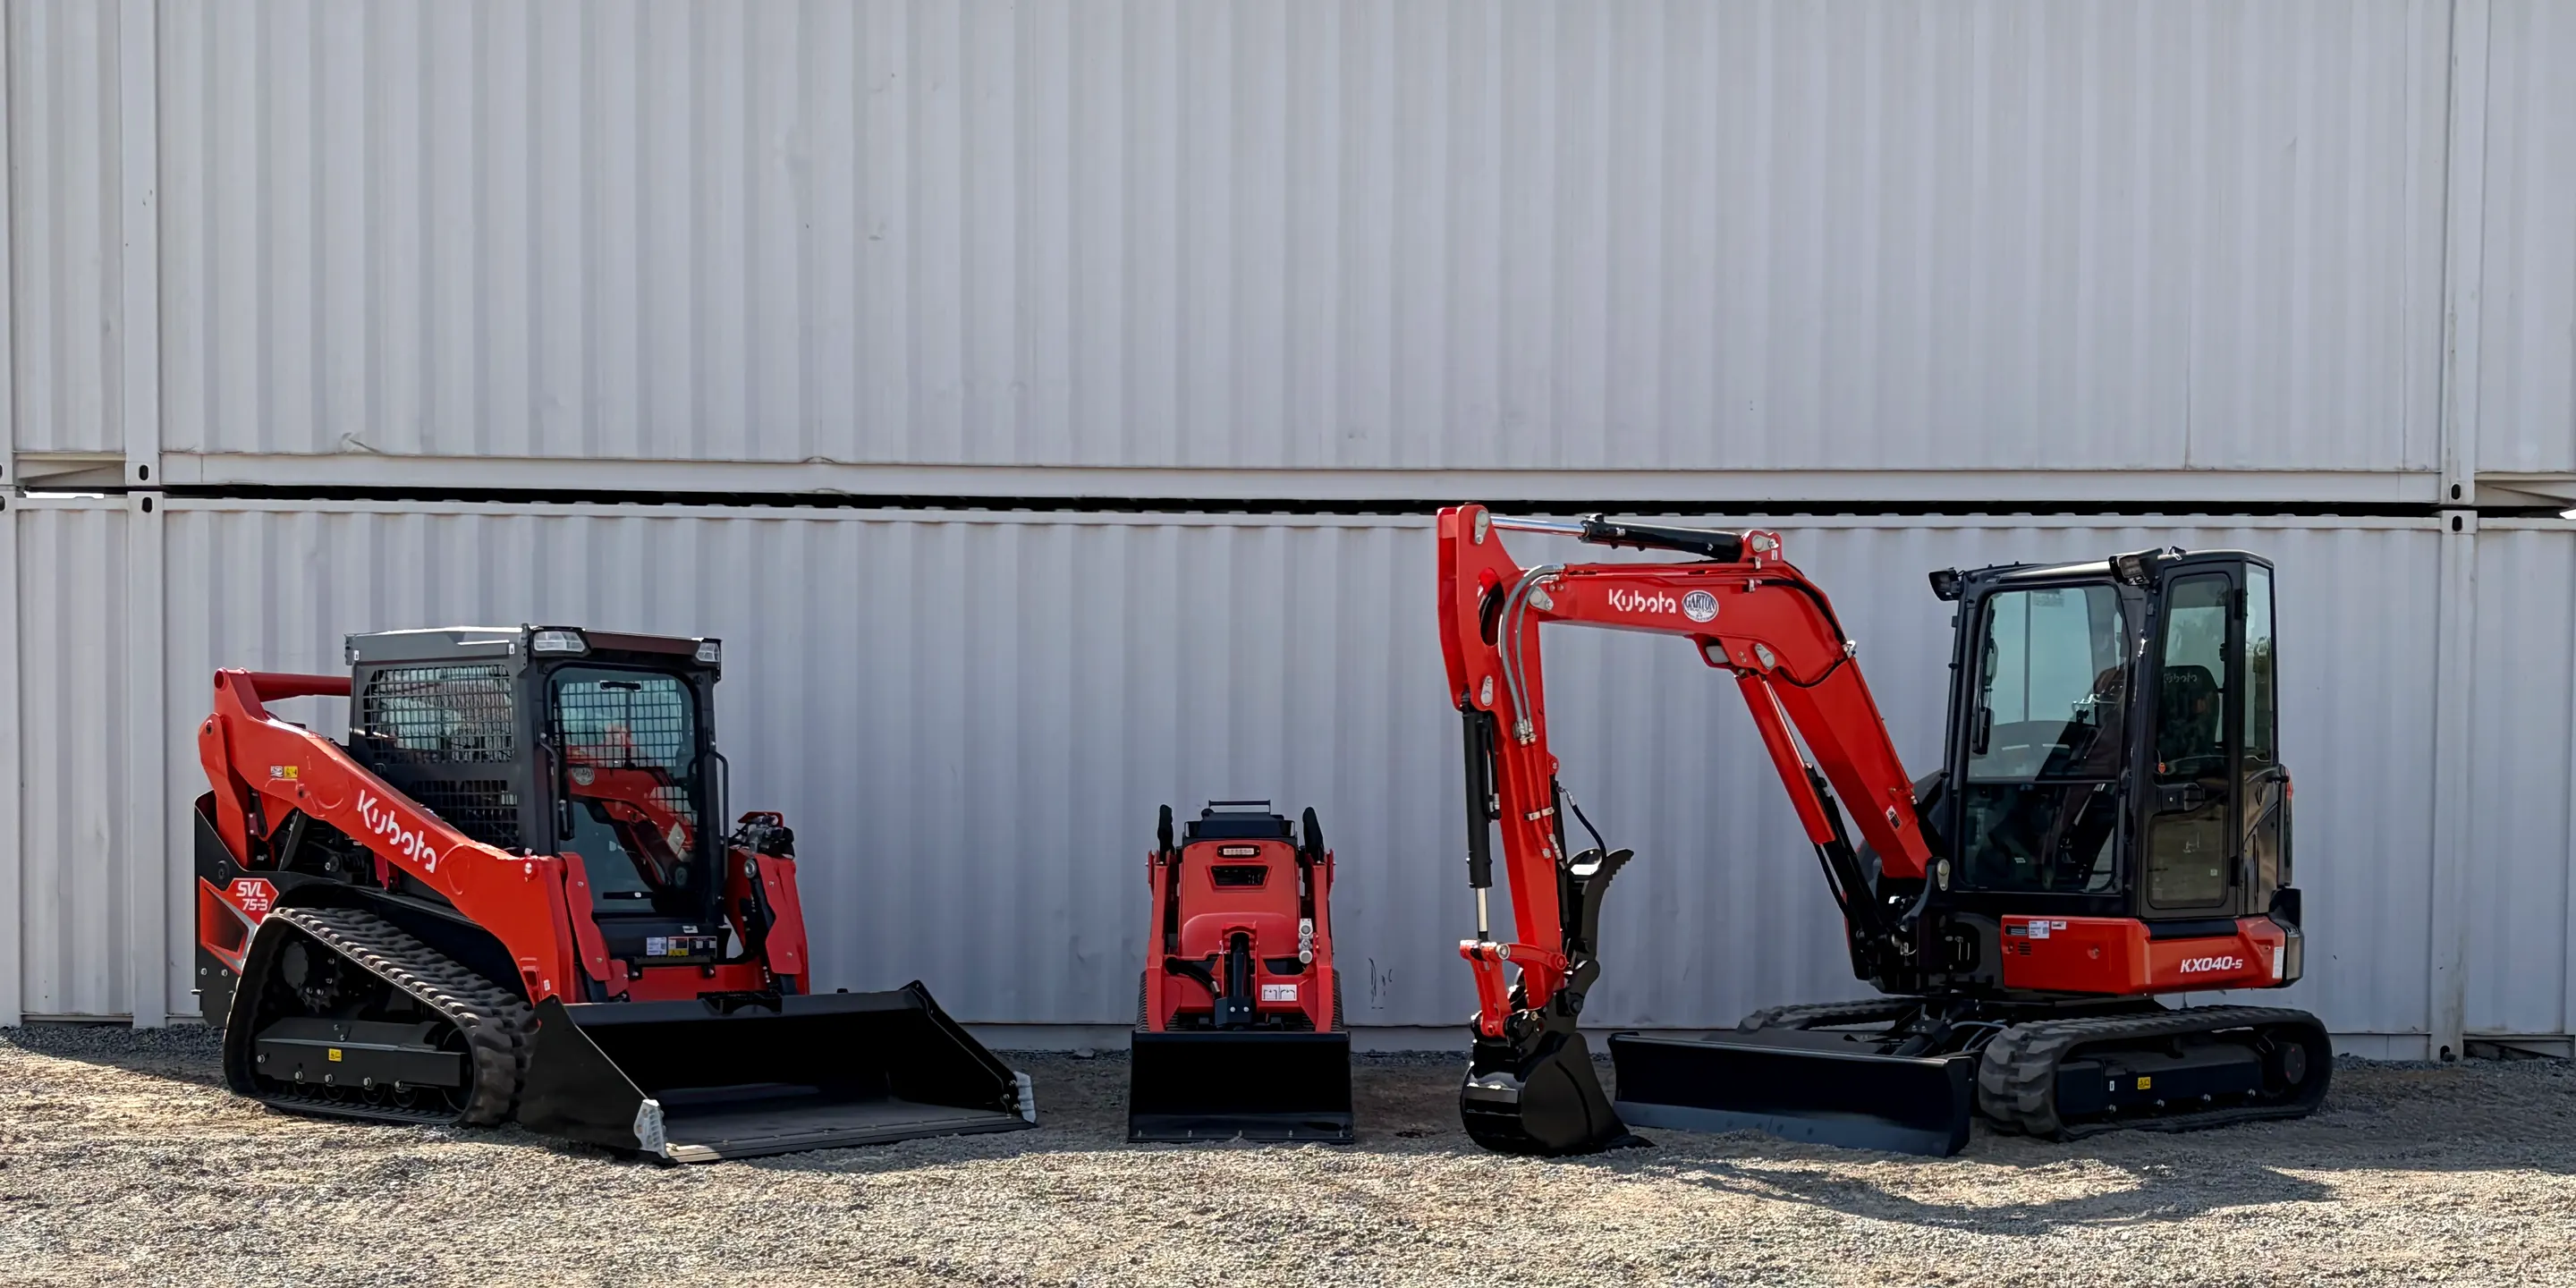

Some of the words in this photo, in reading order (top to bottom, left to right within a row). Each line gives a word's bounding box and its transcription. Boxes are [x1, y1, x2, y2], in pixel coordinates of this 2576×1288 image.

[1608, 589, 1676, 614] Kubota
[1683, 594, 1716, 612] GARTON
[357, 789, 436, 873] Kubota
[236, 881, 267, 897] SVL
[242, 898, 268, 911] 75-3
[2180, 956, 2243, 973] KX040-5
